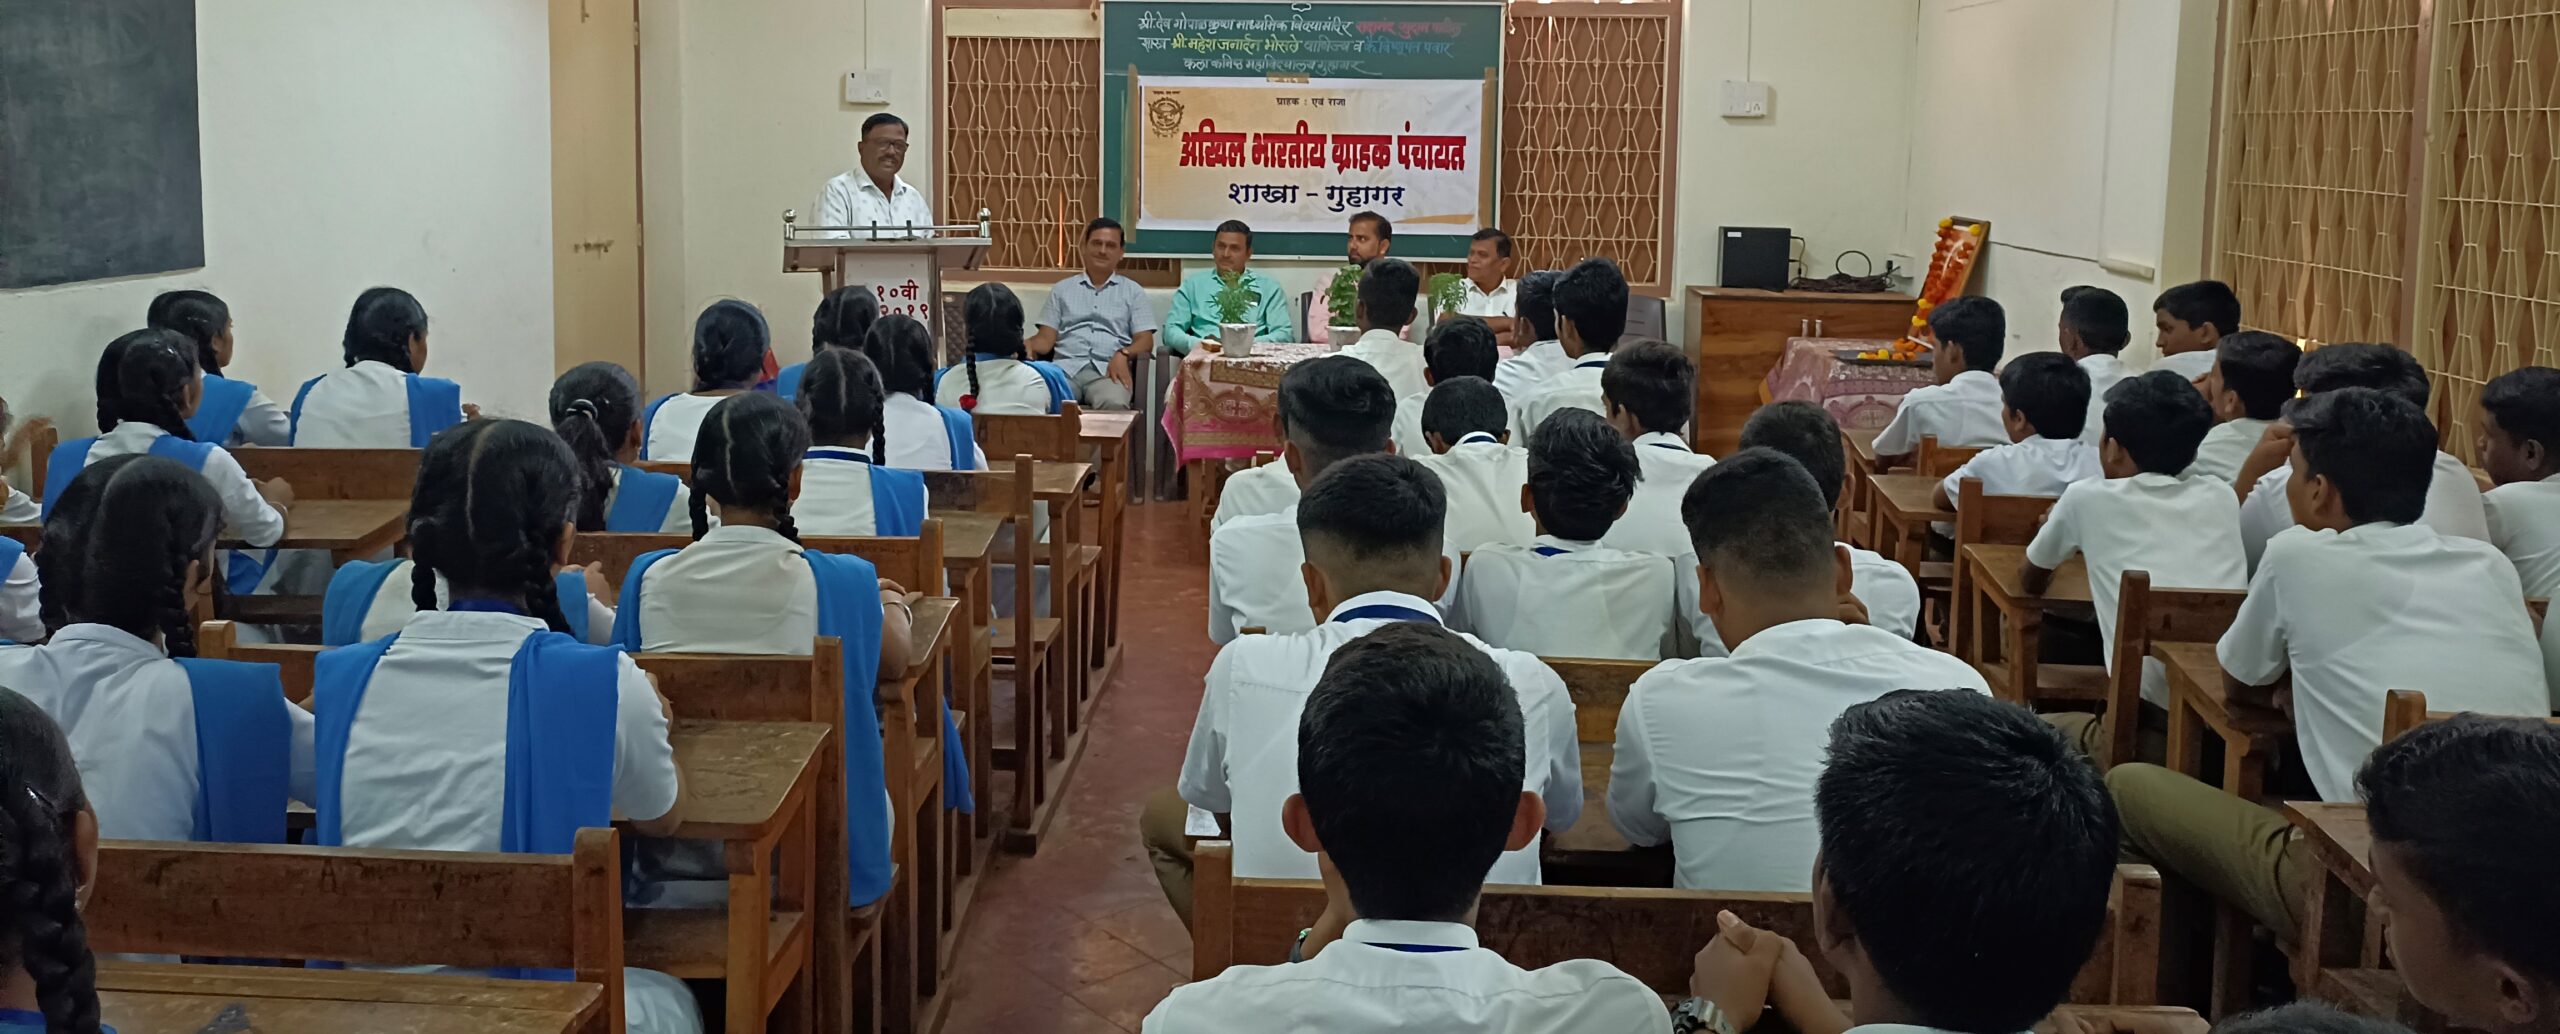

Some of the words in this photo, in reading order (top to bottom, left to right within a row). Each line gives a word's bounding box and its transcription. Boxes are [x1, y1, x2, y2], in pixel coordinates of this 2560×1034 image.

[1353, 40, 1366, 53] व
[1179, 118, 1247, 167] अखिल
[1251, 119, 1327, 169] भारतीय
[1331, 134, 1393, 175] ग्राहक
[1397, 120, 1467, 171] पंचायत
[1229, 182, 1299, 205] शाखा
[1325, 185, 1405, 213] गुहागर
